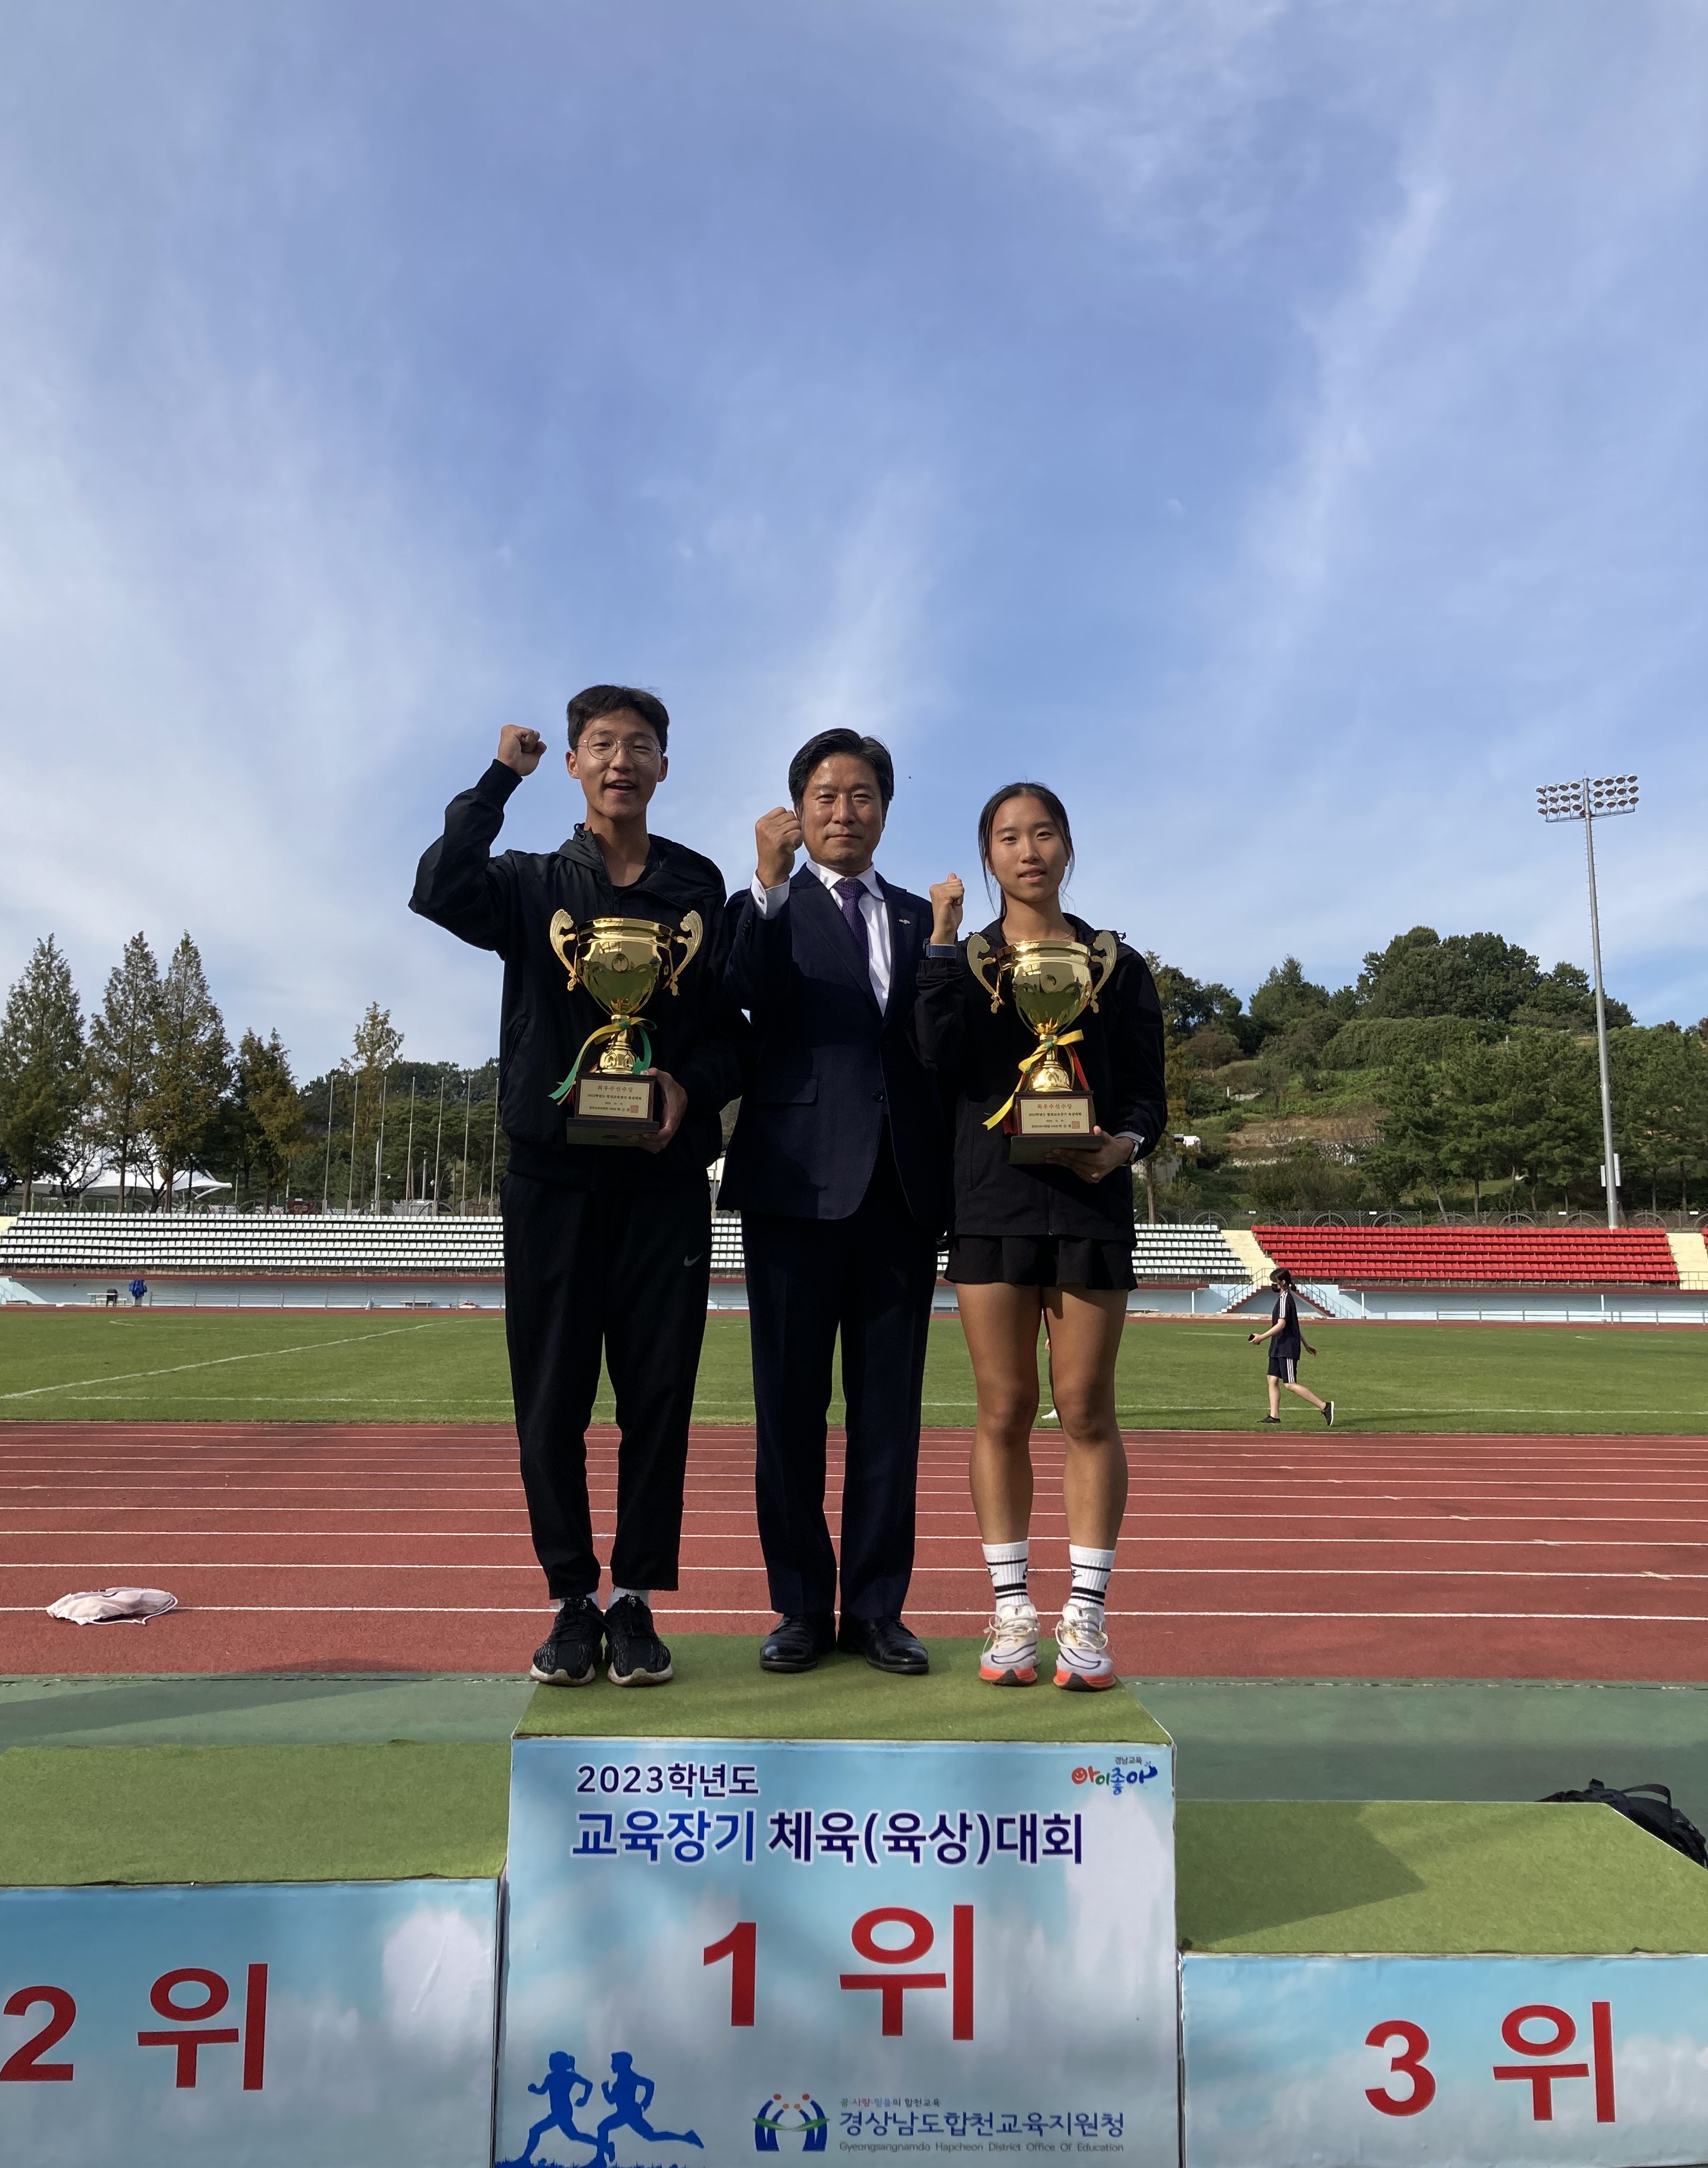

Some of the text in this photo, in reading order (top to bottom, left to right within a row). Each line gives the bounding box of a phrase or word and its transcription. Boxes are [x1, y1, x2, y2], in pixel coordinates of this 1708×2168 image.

[1114, 1756, 1143, 1765] 경남교육
[577, 1763, 759, 1798] 2023학년도
[1071, 1764, 1158, 1796] 아이좋아
[572, 1810, 1082, 1864] 교육장기 체육(육상)대회
[703, 1903, 974, 2040] 1 위
[0, 1963, 268, 2091] 2 위
[1365, 2002, 1616, 2123] 3 위
[839, 2110, 1124, 2138] 경상남도합천교육지원청
[839, 2142, 1124, 2153] Gyeongsangnamdo Hapcheon District Office Of Education
